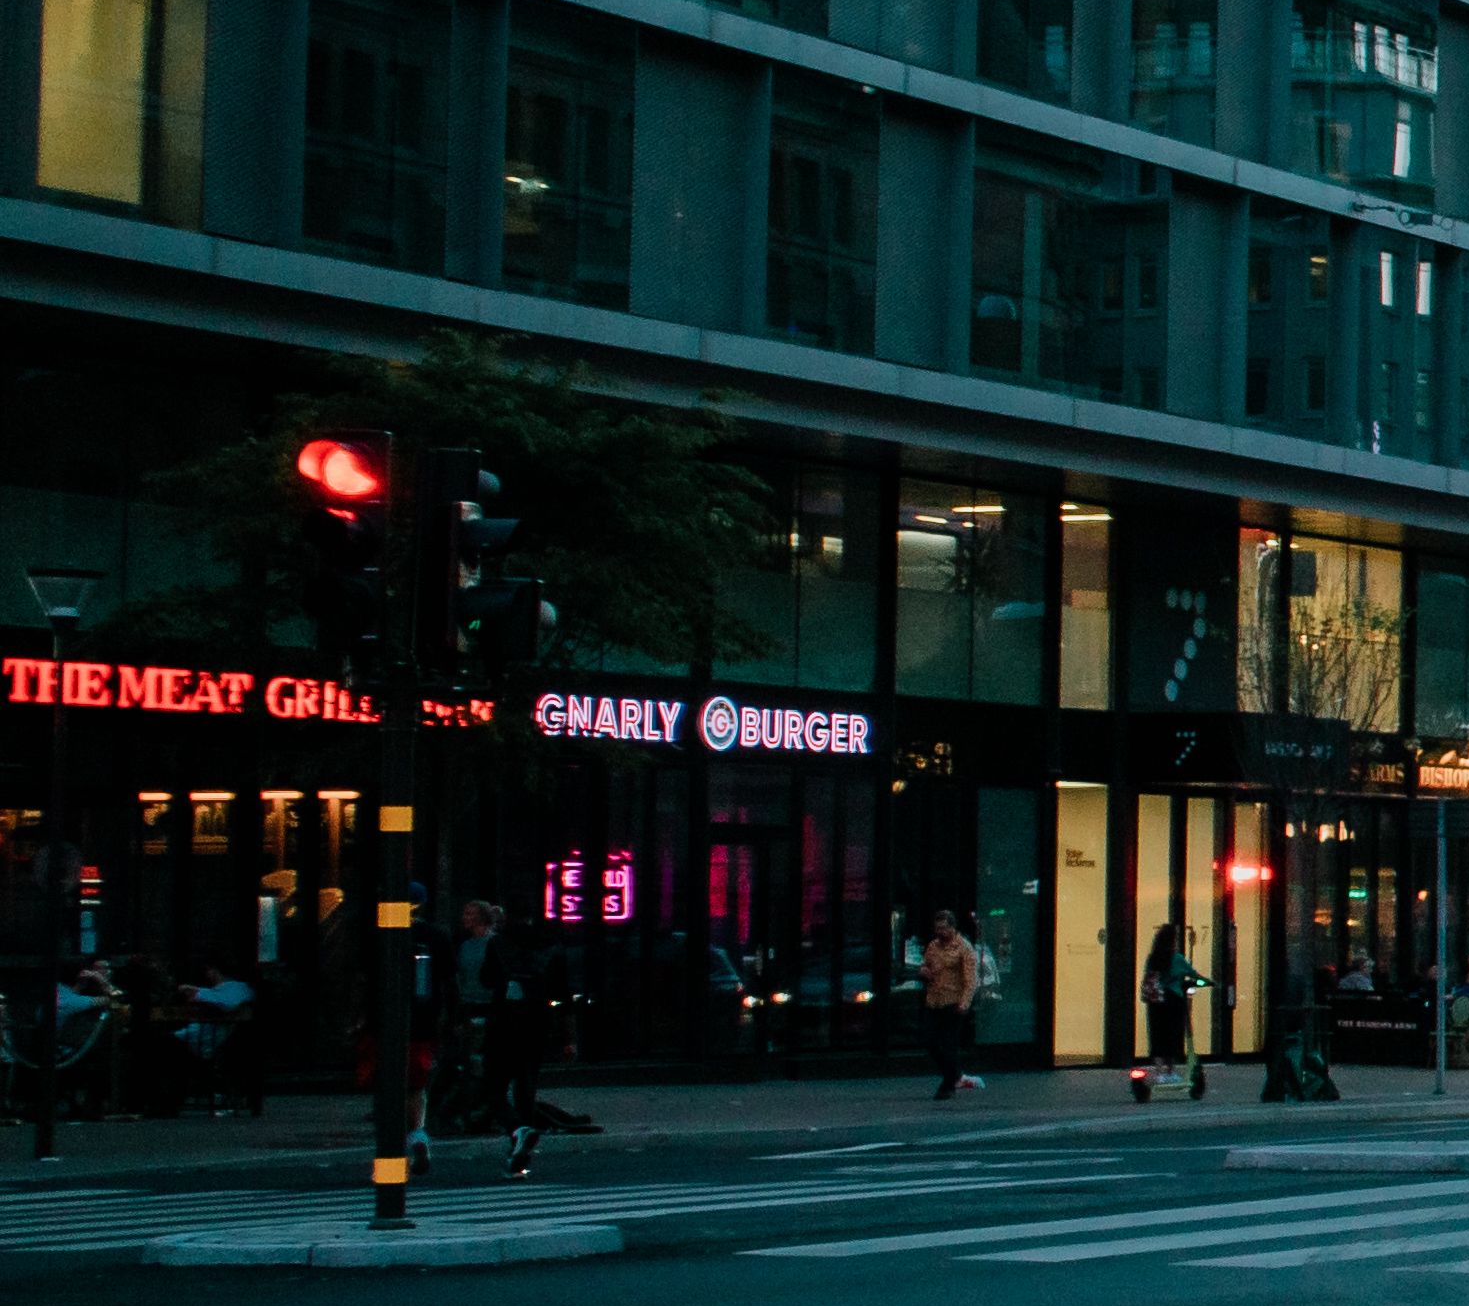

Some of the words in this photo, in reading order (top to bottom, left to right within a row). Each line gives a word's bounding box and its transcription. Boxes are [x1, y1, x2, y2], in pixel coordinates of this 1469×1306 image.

[2, 657, 112, 706] THE
[117, 665, 254, 714] MEAT
[265, 676, 382, 724] GRILL
[534, 692, 683, 742] GNARLY
[739, 706, 869, 754] BURGER
